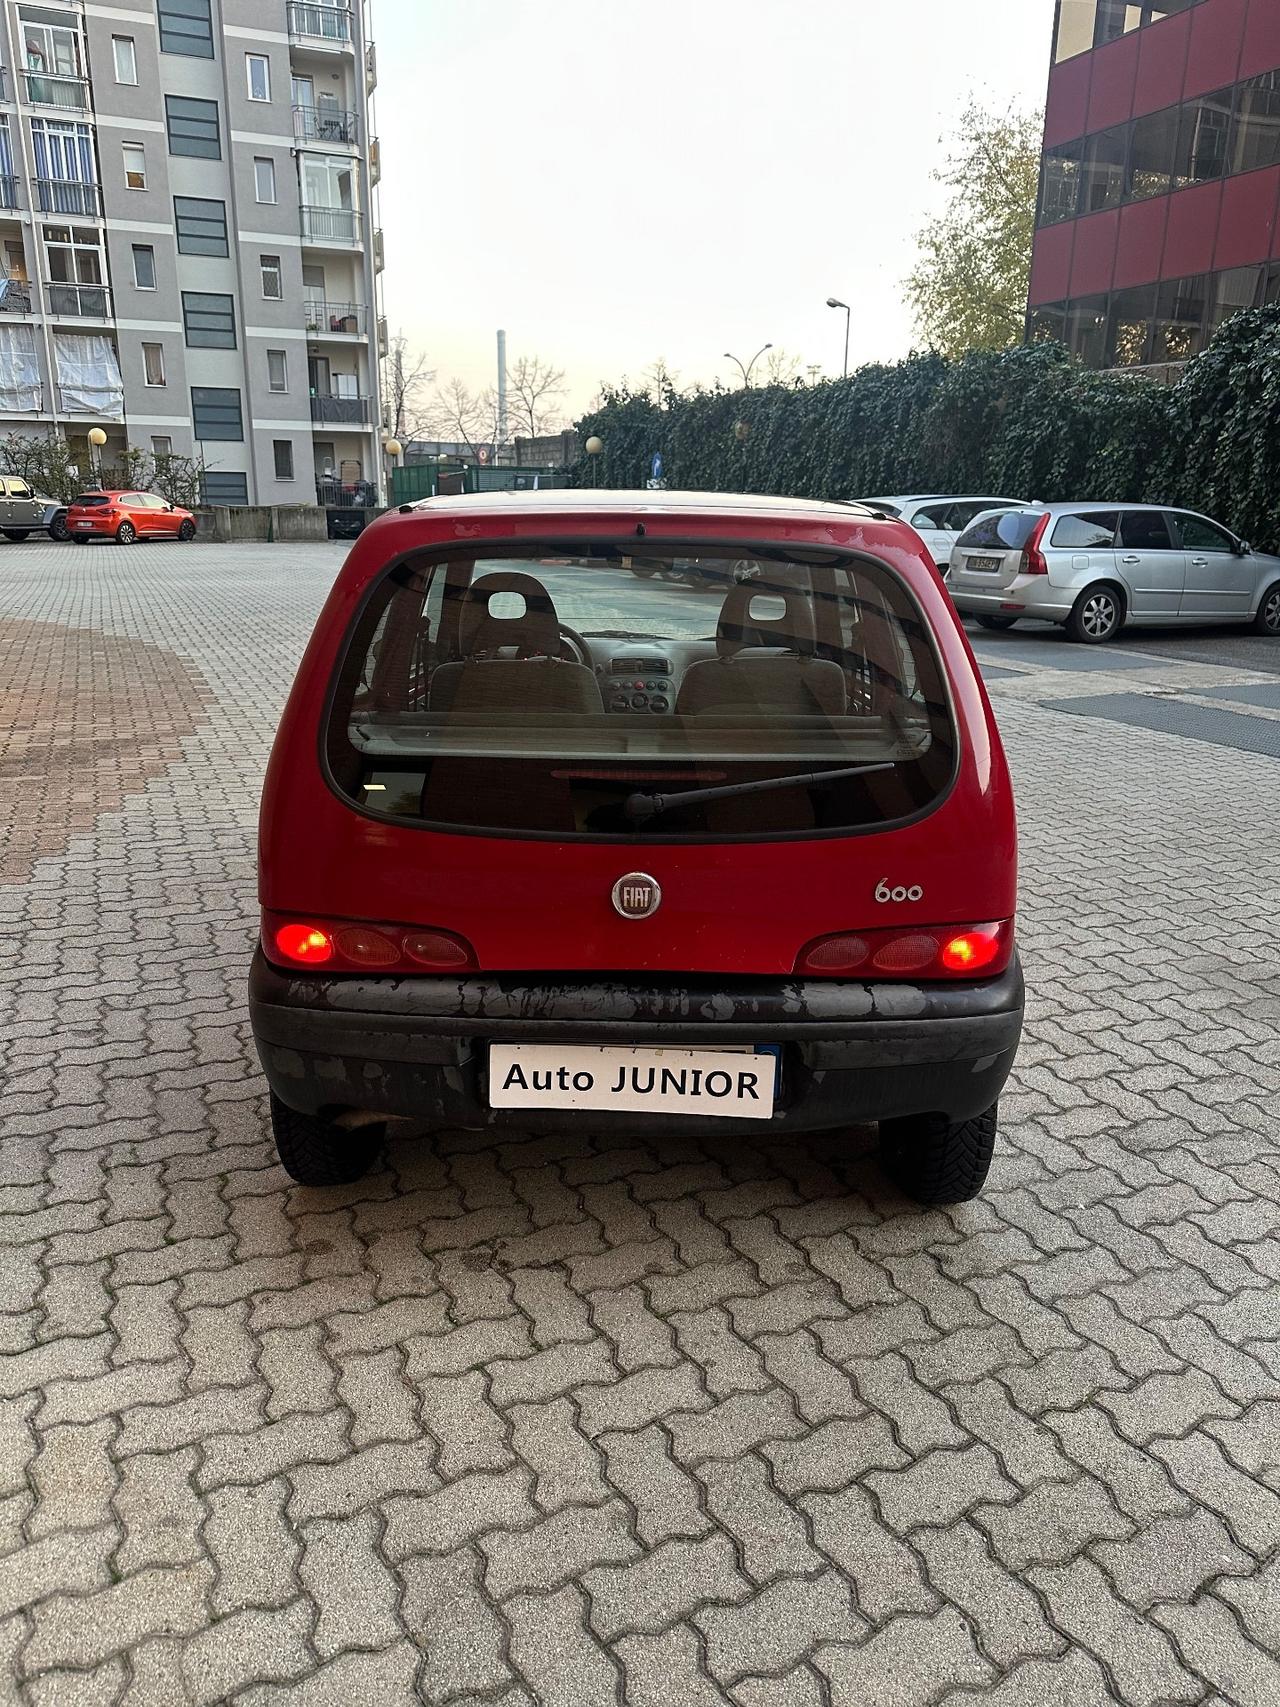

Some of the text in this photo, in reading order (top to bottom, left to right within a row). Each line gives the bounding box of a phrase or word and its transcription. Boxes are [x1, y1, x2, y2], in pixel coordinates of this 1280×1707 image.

[623, 886, 651, 908] FIAT
[875, 877, 923, 903] 600
[502, 1063, 760, 1100] Auto JUNIOR
